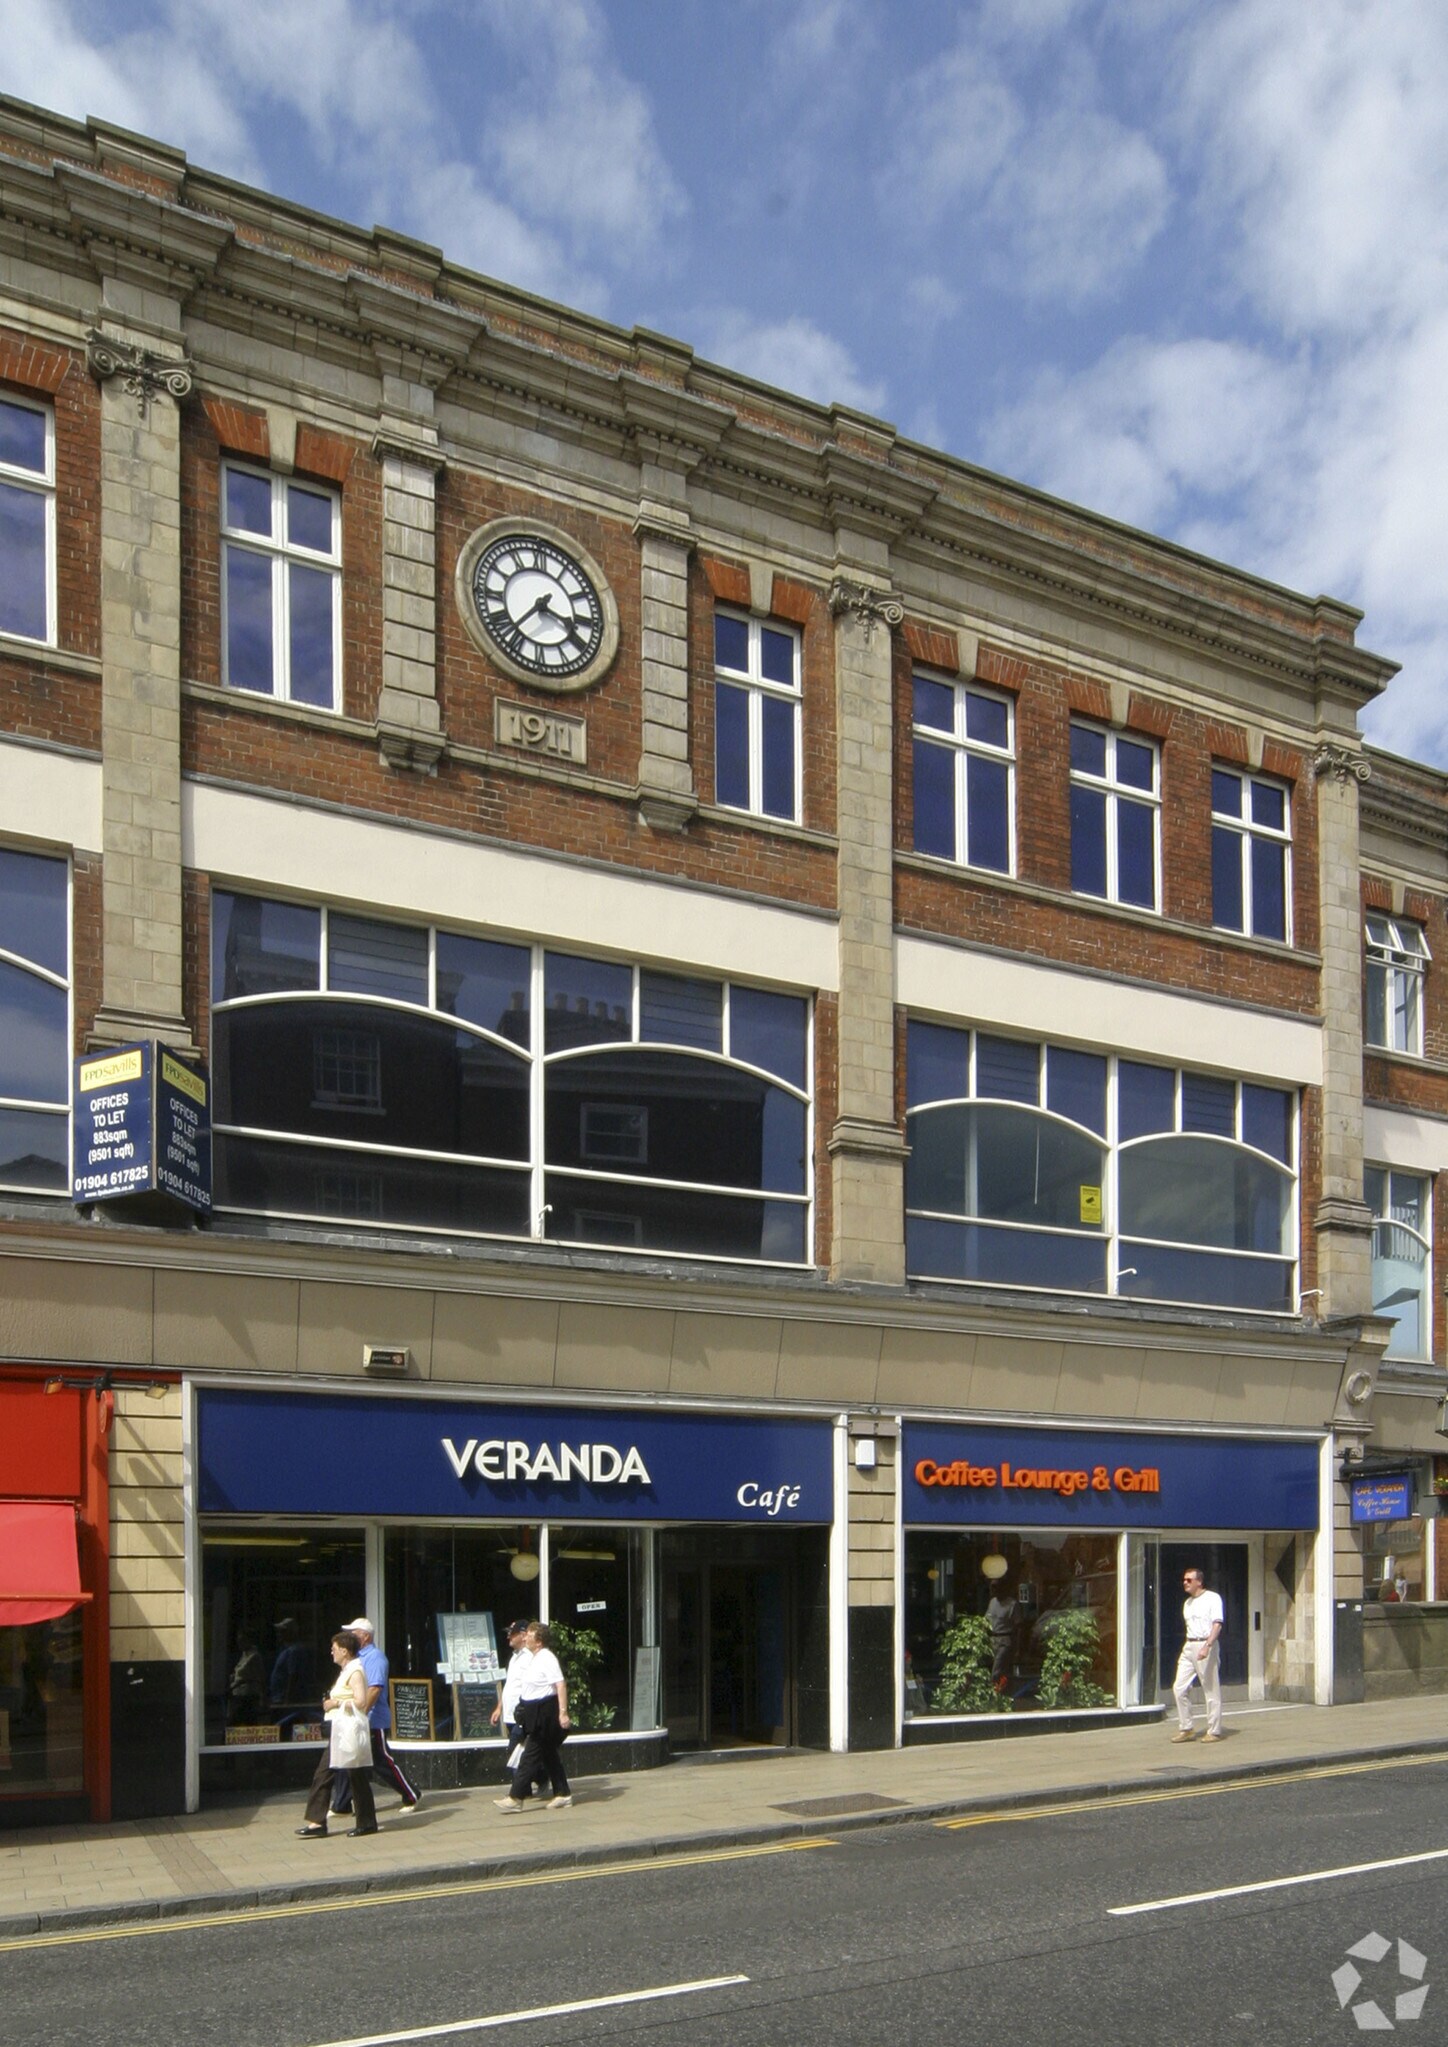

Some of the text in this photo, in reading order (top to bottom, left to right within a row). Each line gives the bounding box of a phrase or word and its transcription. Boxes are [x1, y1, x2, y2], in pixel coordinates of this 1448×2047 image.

[510, 710, 570, 753] 1911
[90, 1092, 129, 1112] OFFICES
[169, 1097, 198, 1125] OFFICES
[93, 1109, 125, 1128] TO LET
[172, 1114, 196, 1139] TO LET
[93, 1129, 128, 1145] 883sqm
[88, 1142, 134, 1165] (9501 sqft)
[75, 1165, 149, 1192] 01904 617825
[158, 1166, 183, 1191] 01904
[183, 1181, 211, 1206] 617825
[441, 1438, 652, 1485] VERANDA
[914, 1459, 1160, 1496] Coffee Lounge & Grill
[736, 1483, 801, 1516] Café
